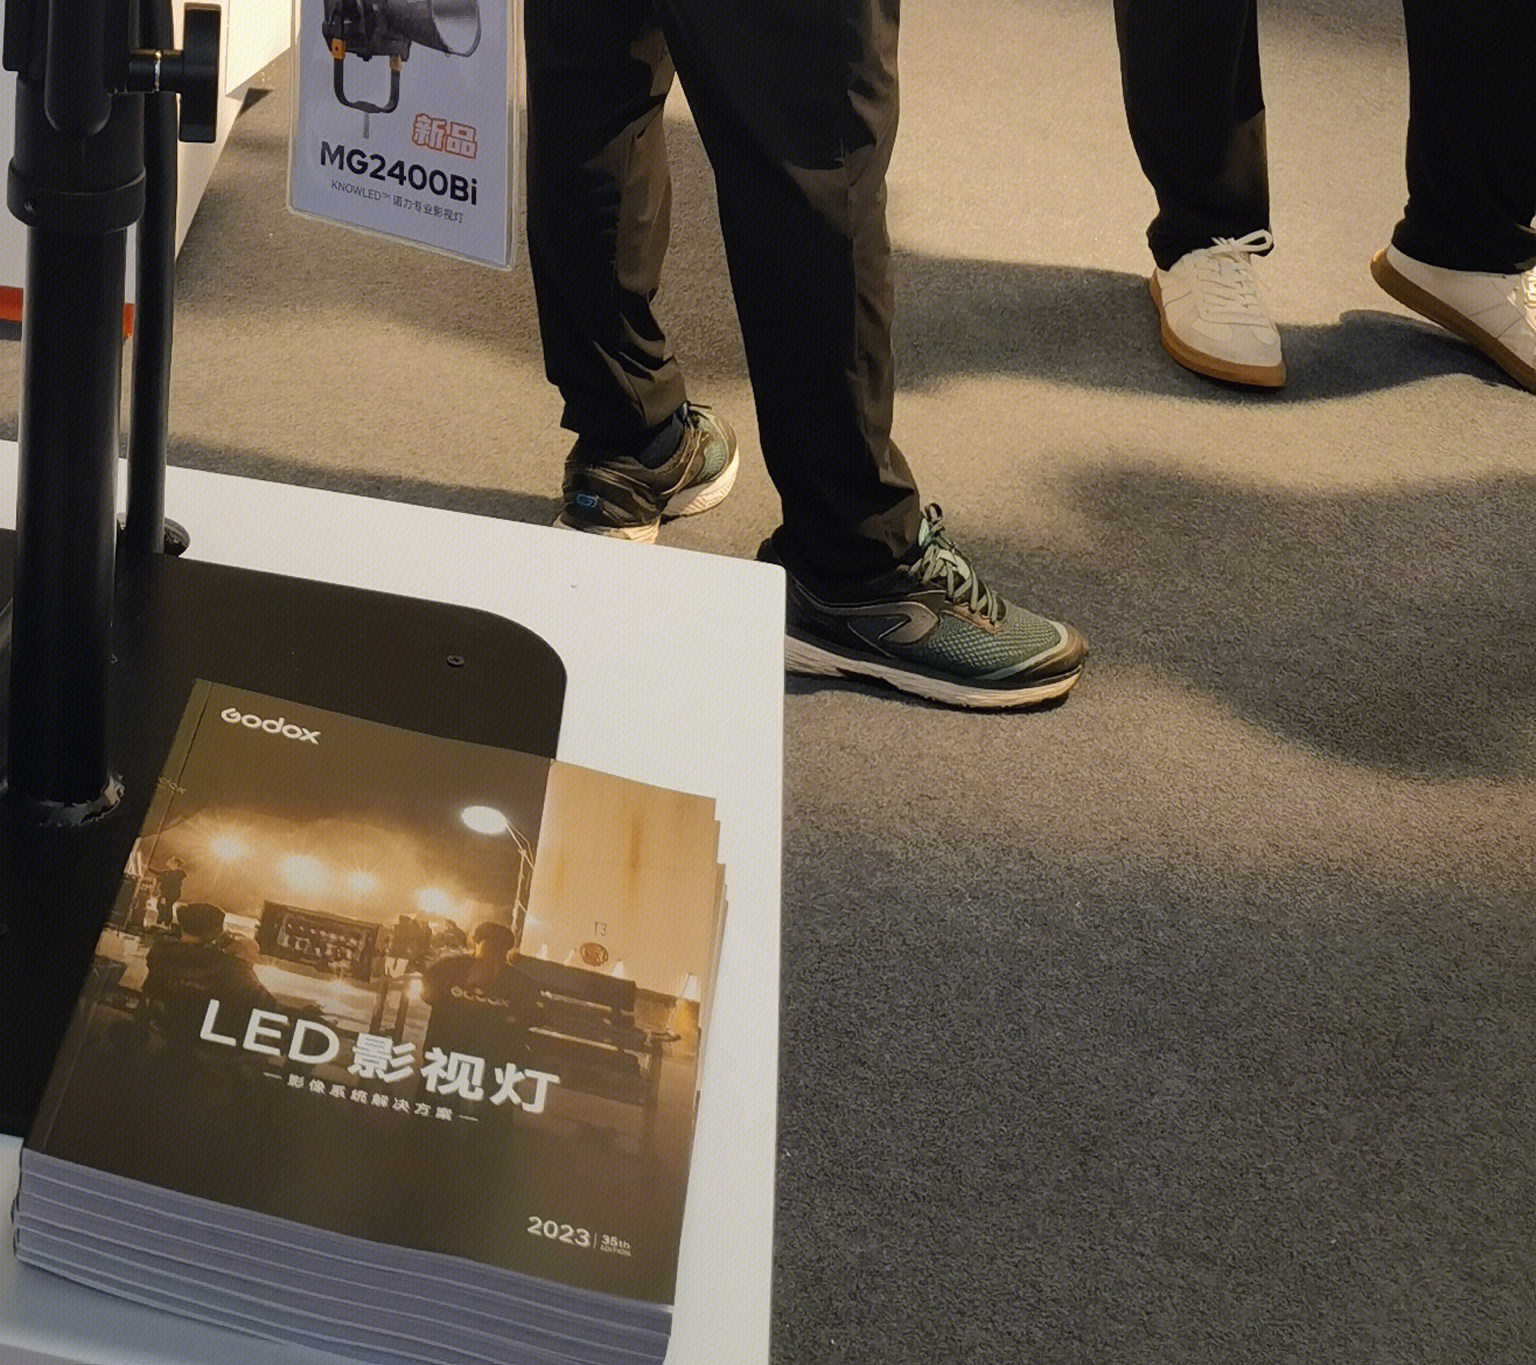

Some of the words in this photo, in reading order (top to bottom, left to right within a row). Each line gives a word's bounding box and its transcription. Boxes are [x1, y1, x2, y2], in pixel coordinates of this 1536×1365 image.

[412, 112, 477, 159] 新品
[320, 140, 477, 206] MG2400Bi
[220, 707, 322, 745] Godox
[593, 921, 608, 937] T3
[200, 998, 341, 1065] LED
[347, 1031, 561, 1115] 影视灯
[286, 1073, 454, 1122] 影像系统解决方案
[526, 1215, 591, 1248] 2023
[601, 1233, 631, 1249] 35th
